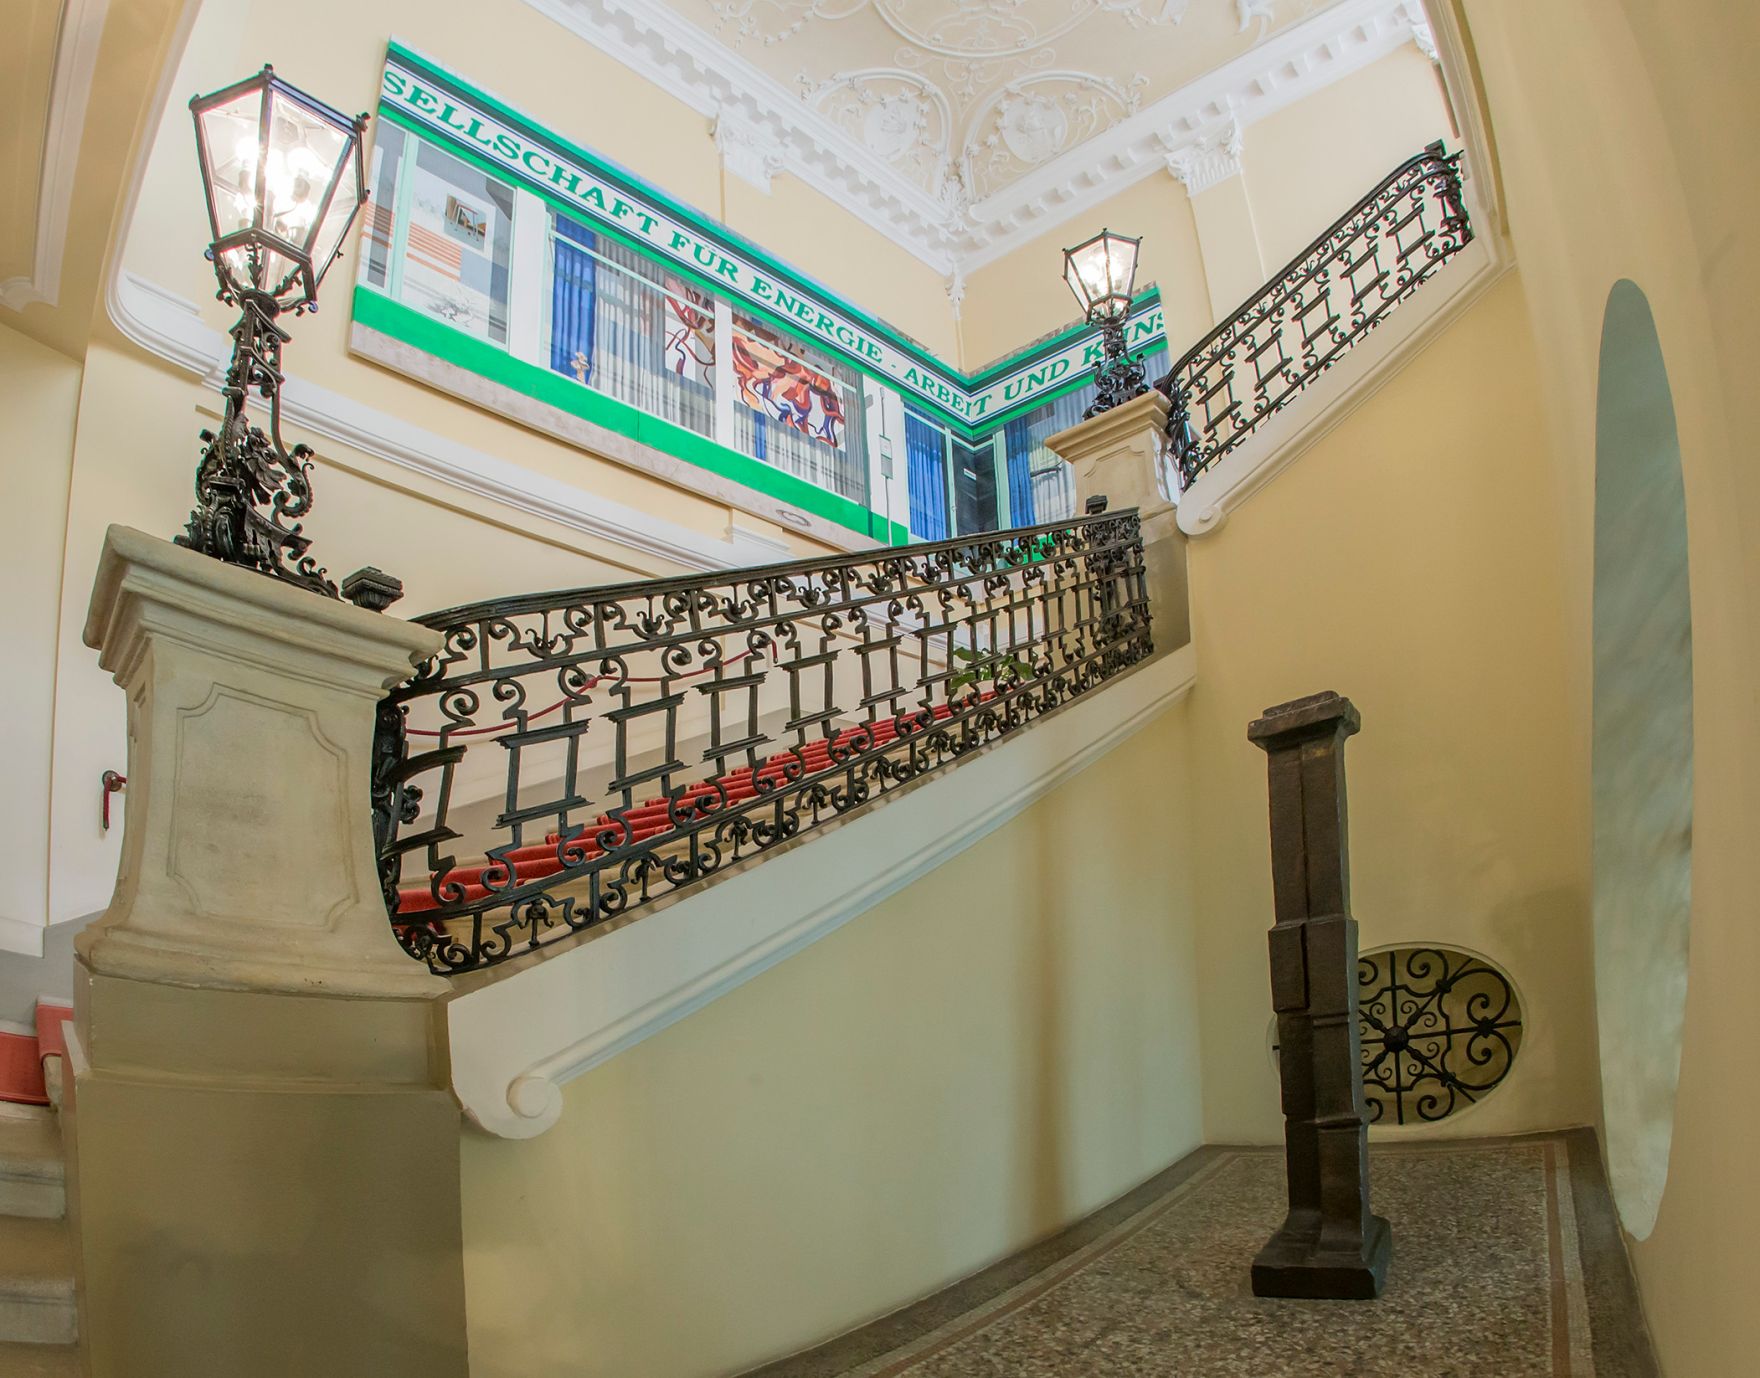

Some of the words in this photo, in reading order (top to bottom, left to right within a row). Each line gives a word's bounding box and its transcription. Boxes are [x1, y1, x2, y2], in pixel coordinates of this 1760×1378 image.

[383, 70, 658, 235] SELLSCHAFT
[667, 229, 739, 283] FÜR
[750, 274, 883, 363] ENERGIE
[904, 366, 992, 418] ARBEIT
[1003, 359, 1070, 401] UND
